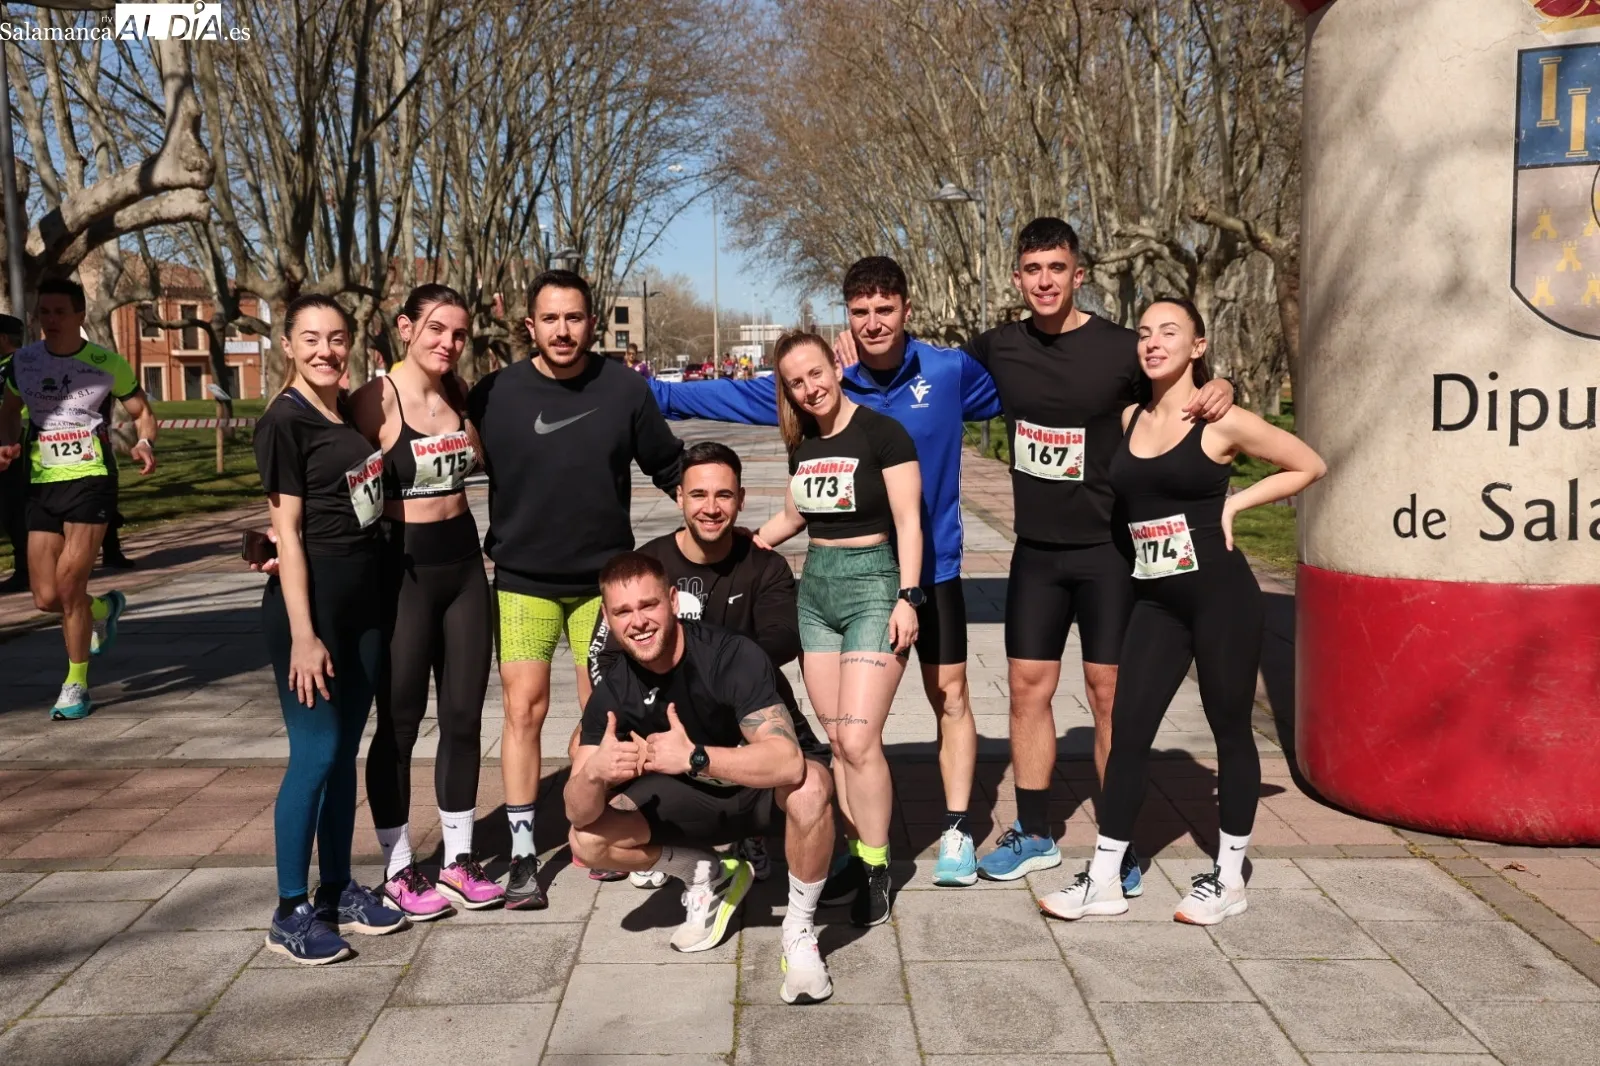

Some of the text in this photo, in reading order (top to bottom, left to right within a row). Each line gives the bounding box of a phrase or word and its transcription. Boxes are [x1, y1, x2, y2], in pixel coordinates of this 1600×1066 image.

[1432, 371, 1598, 447] Dipu
[39, 430, 91, 442] bedunia
[1017, 422, 1084, 445] bedunia
[51, 441, 83, 457] 123
[1028, 442, 1069, 467] 167
[433, 450, 468, 478] 175
[796, 460, 855, 476] bedunia
[803, 475, 839, 498] 173
[1393, 492, 1447, 541] de
[1142, 537, 1178, 564] 174
